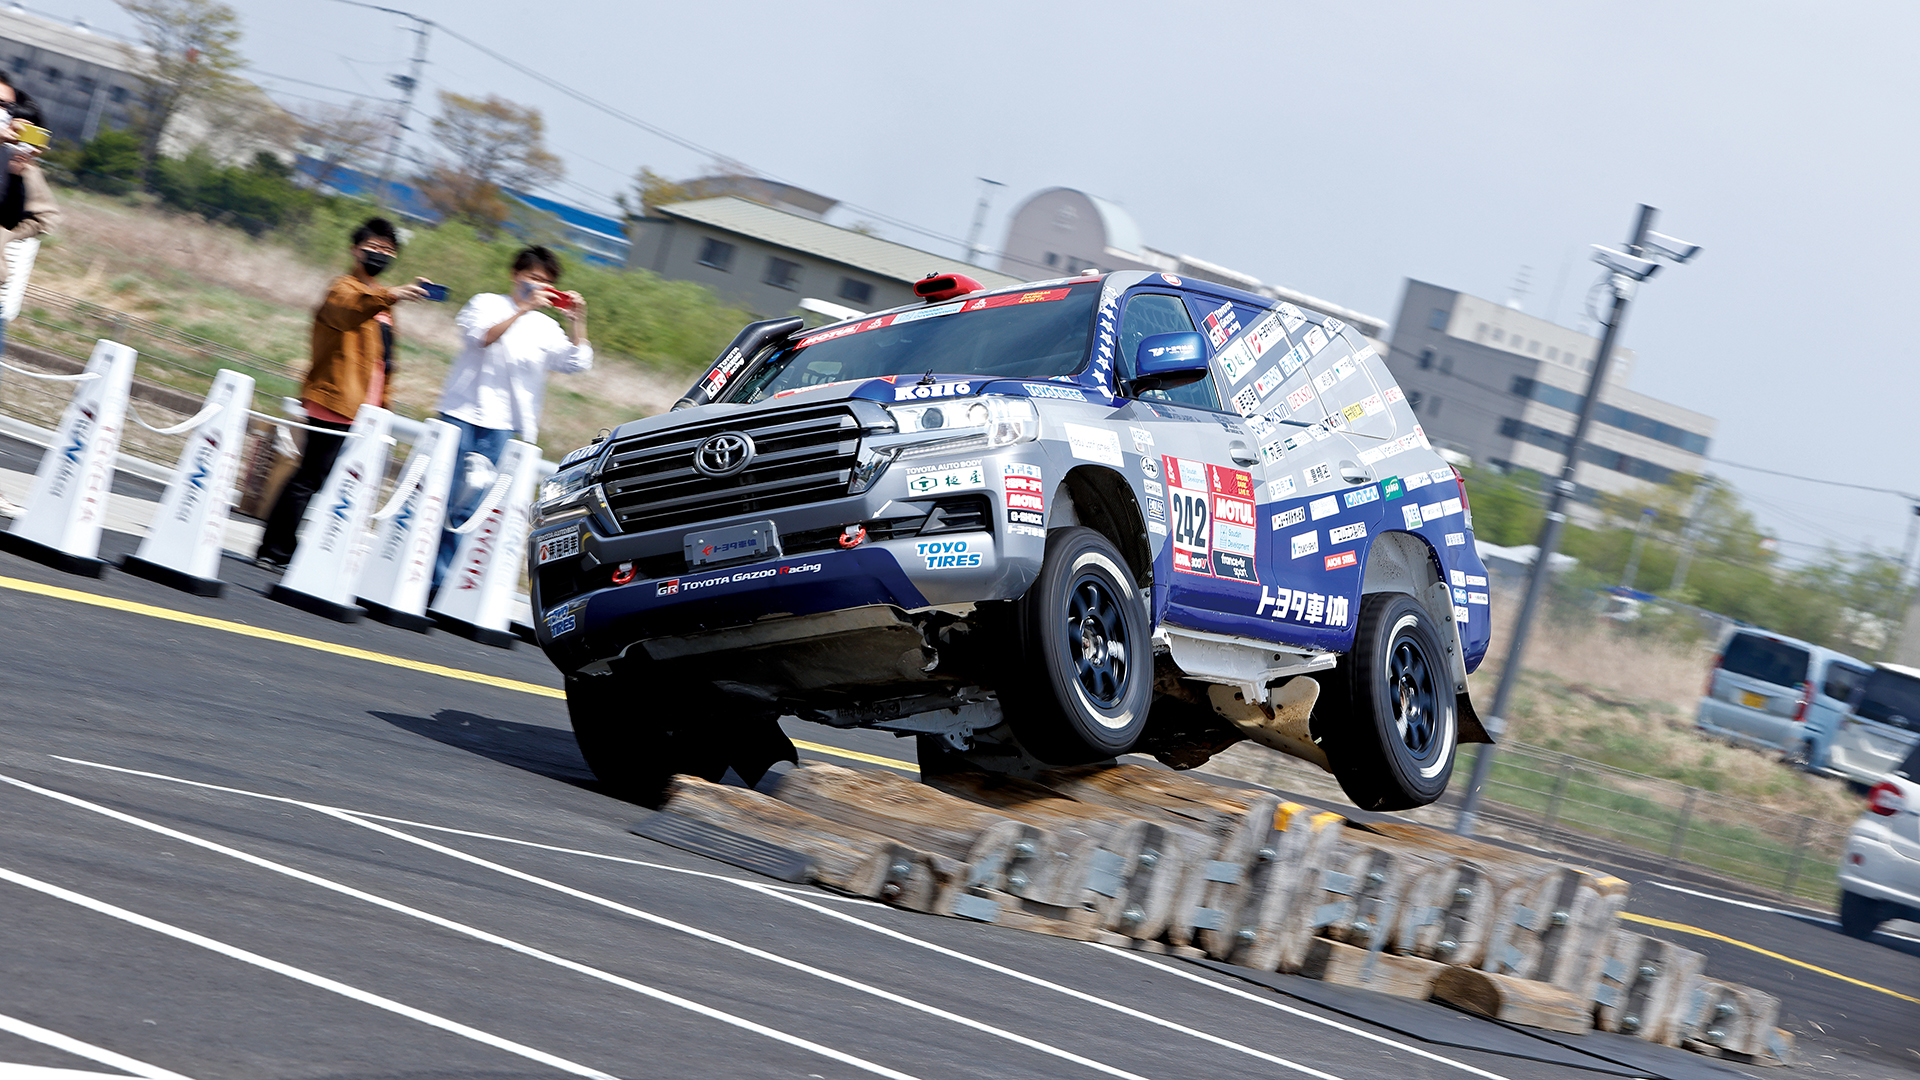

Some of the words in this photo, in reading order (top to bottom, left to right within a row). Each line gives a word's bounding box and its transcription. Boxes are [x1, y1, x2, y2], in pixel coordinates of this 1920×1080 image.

[803, 326, 857, 346] MOTUL
[707, 374, 728, 398] GR
[1287, 385, 1313, 410] DENSO
[905, 465, 937, 475] TOYOTA
[937, 462, 960, 471] AUTO
[960, 459, 983, 468] BODY
[1009, 493, 1043, 510] MOTUL
[1216, 498, 1255, 525] MOTUL
[1173, 493, 1207, 548] 242
[457, 506, 507, 591] TOYOTA
[714, 538, 758, 553] トヨタ車体
[917, 541, 968, 555] TOYO
[1227, 540, 1250, 552] Development
[926, 553, 981, 568] TIRES
[1325, 556, 1341, 569] AICHI
[1340, 553, 1355, 565] STEEL
[657, 584, 679, 598] GR
[681, 575, 731, 592] TOYOTA
[732, 568, 777, 584] GAZOO
[778, 562, 822, 578] Racing
[1232, 566, 1249, 579] sport
[1256, 585, 1349, 627] トヨタ車体
[550, 616, 576, 637] TIRES
